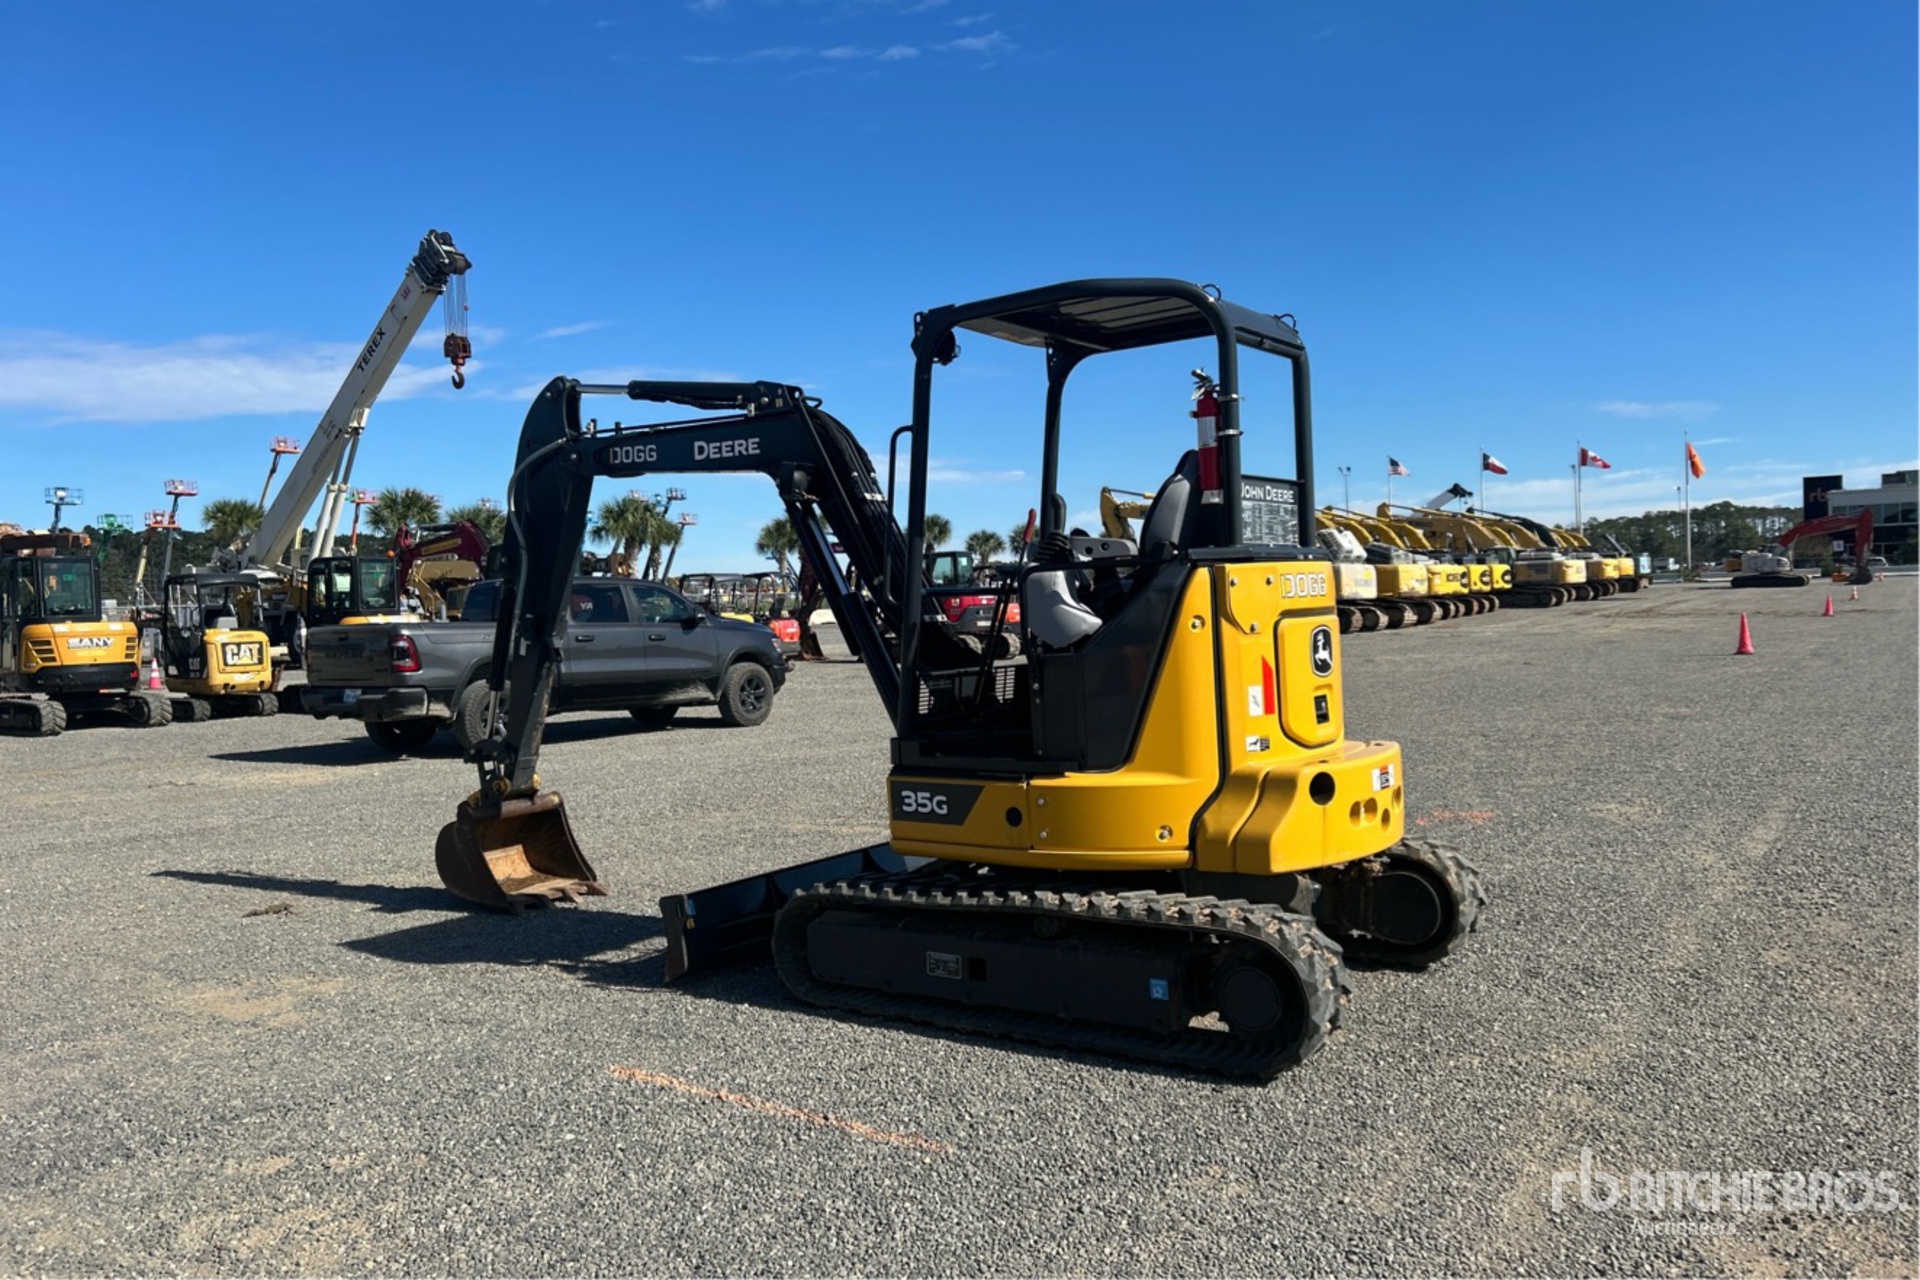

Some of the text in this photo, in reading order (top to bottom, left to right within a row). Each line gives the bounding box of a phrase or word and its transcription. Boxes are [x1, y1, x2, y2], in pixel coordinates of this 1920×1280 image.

[356, 327, 386, 372] TEREX
[694, 438, 760, 460] DEERE
[1241, 482, 1295, 503] JOHN DEERE
[225, 643, 260, 666] CAT
[901, 790, 948, 815] 35G
